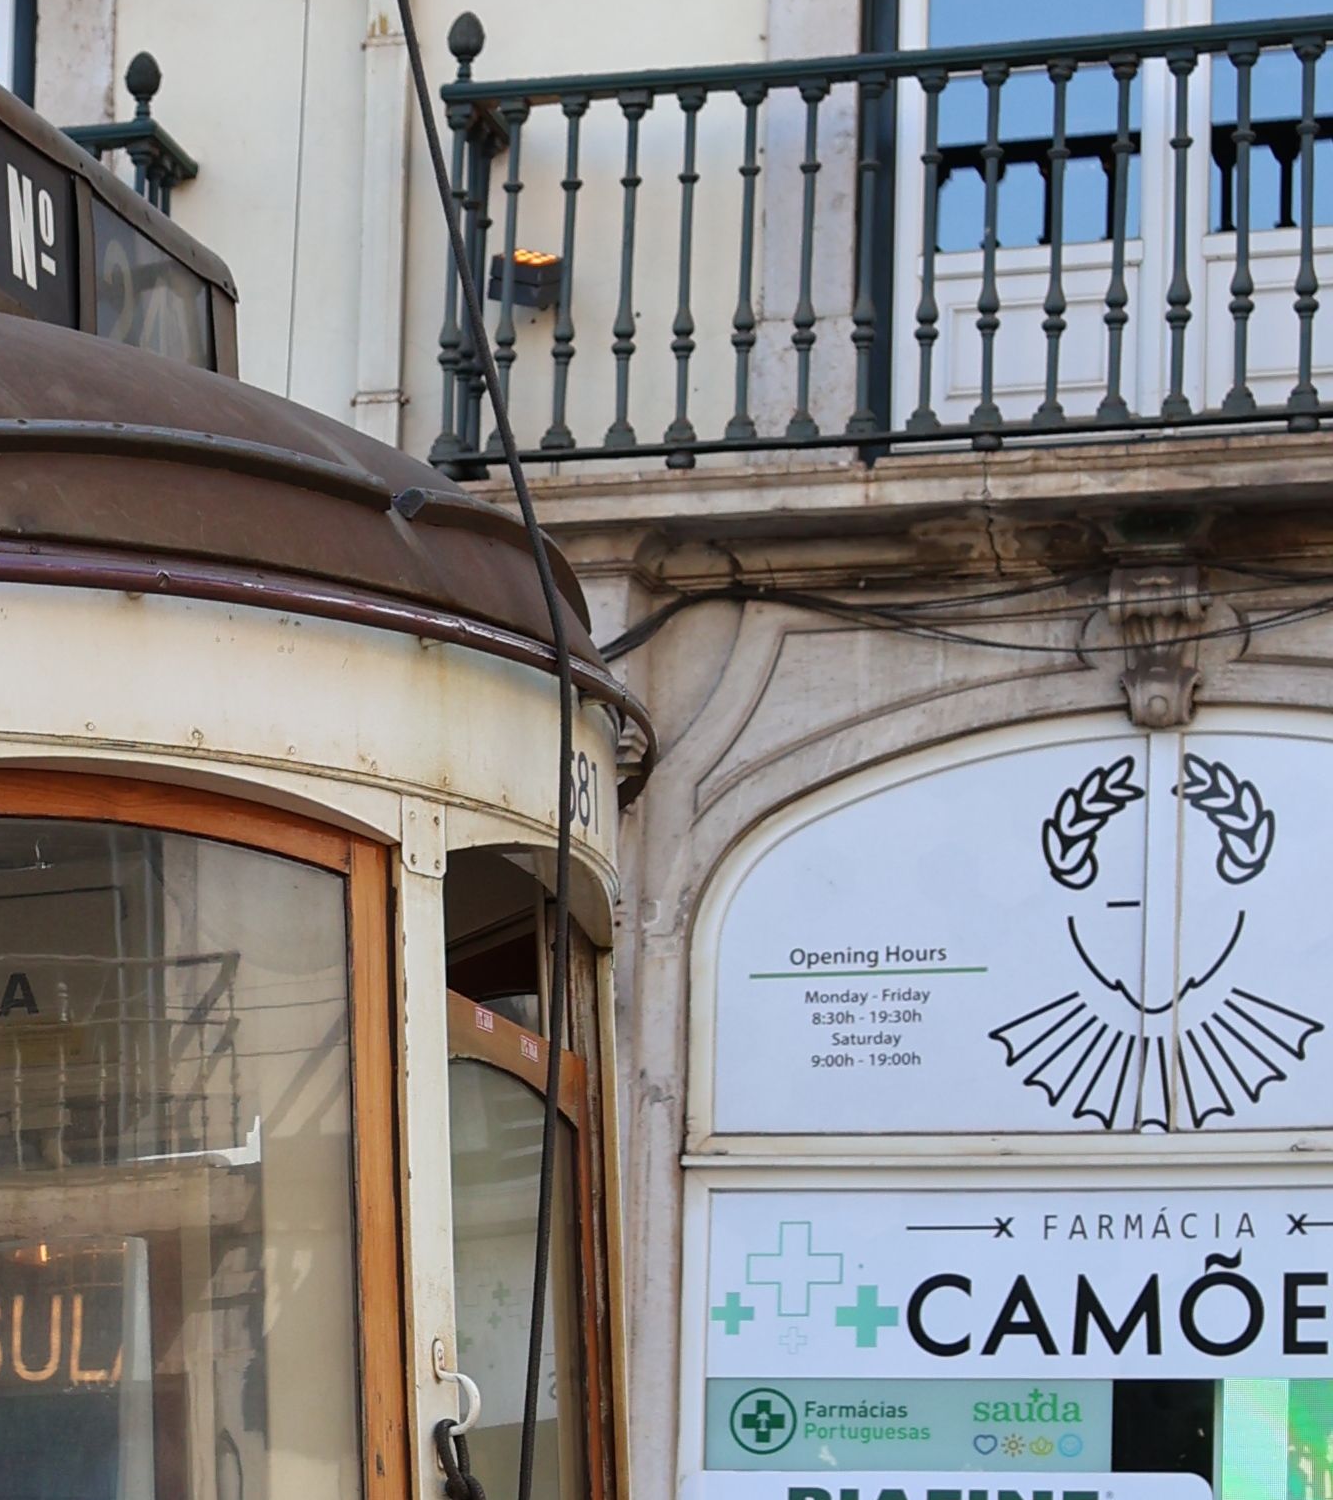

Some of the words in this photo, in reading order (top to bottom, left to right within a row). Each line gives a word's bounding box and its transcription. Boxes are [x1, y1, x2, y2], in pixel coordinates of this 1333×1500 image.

[789, 946, 880, 969] Opening
[884, 945, 948, 963] Hours
[804, 989, 869, 1006] Monday
[881, 987, 931, 1004] Friday
[811, 1009, 855, 1026] 8:30h
[869, 1008, 922, 1024] 19:30h
[831, 1030, 902, 1048] Saturday
[811, 1052, 855, 1068] 9:00h
[868, 1051, 922, 1067] 19:00h
[1043, 1206, 1256, 1240] FARMÁCIA
[906, 1247, 1330, 1357] CAMÕE
[804, 1399, 909, 1419] Farmácias
[803, 1422, 931, 1445] Portuguesas
